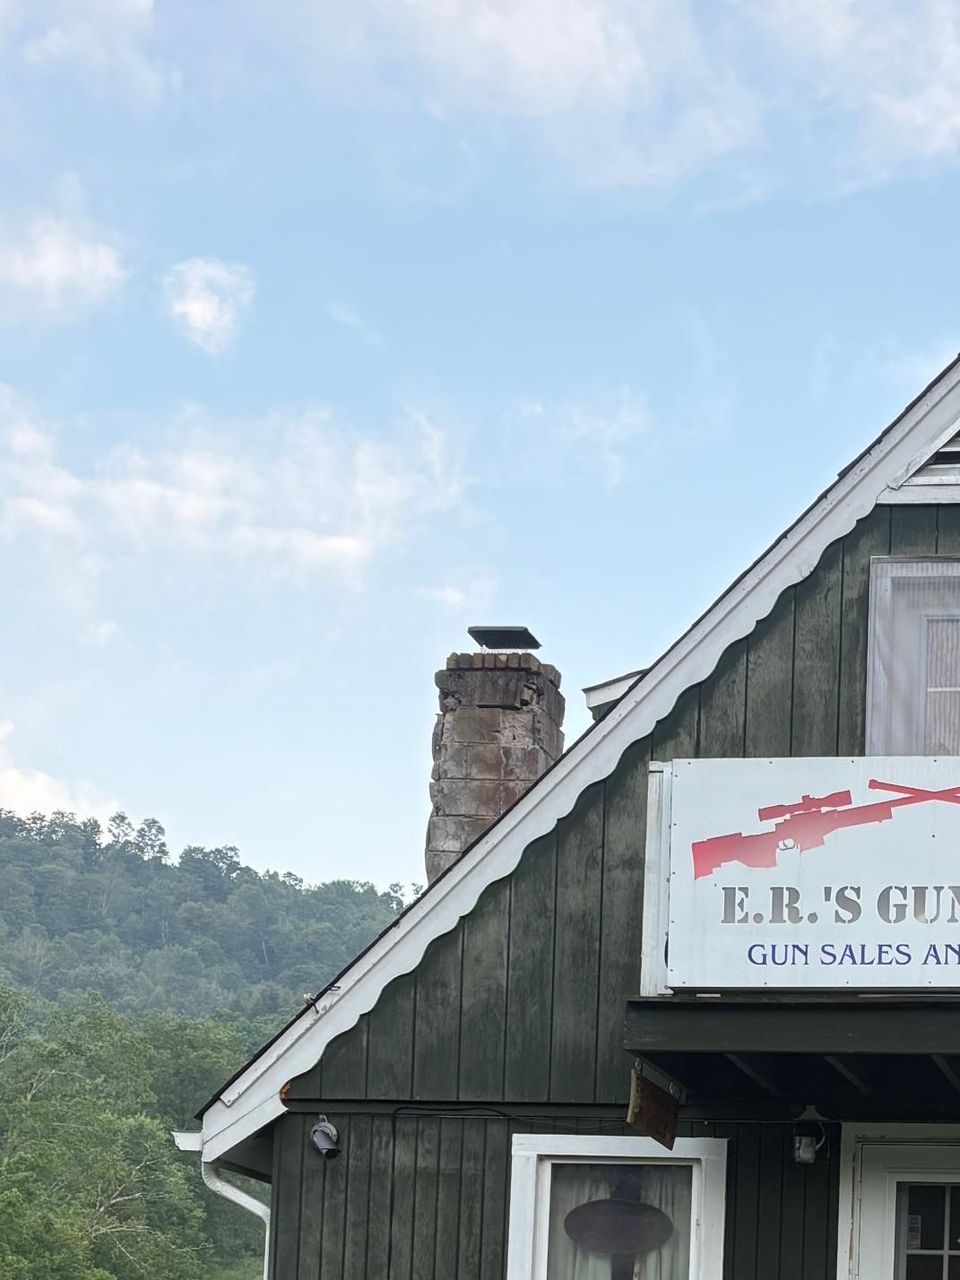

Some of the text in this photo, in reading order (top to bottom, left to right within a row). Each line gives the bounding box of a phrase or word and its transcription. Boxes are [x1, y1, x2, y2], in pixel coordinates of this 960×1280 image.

[721, 886, 861, 924] E.R.'S
[748, 944, 809, 966] GUN
[820, 944, 911, 966] SALES
